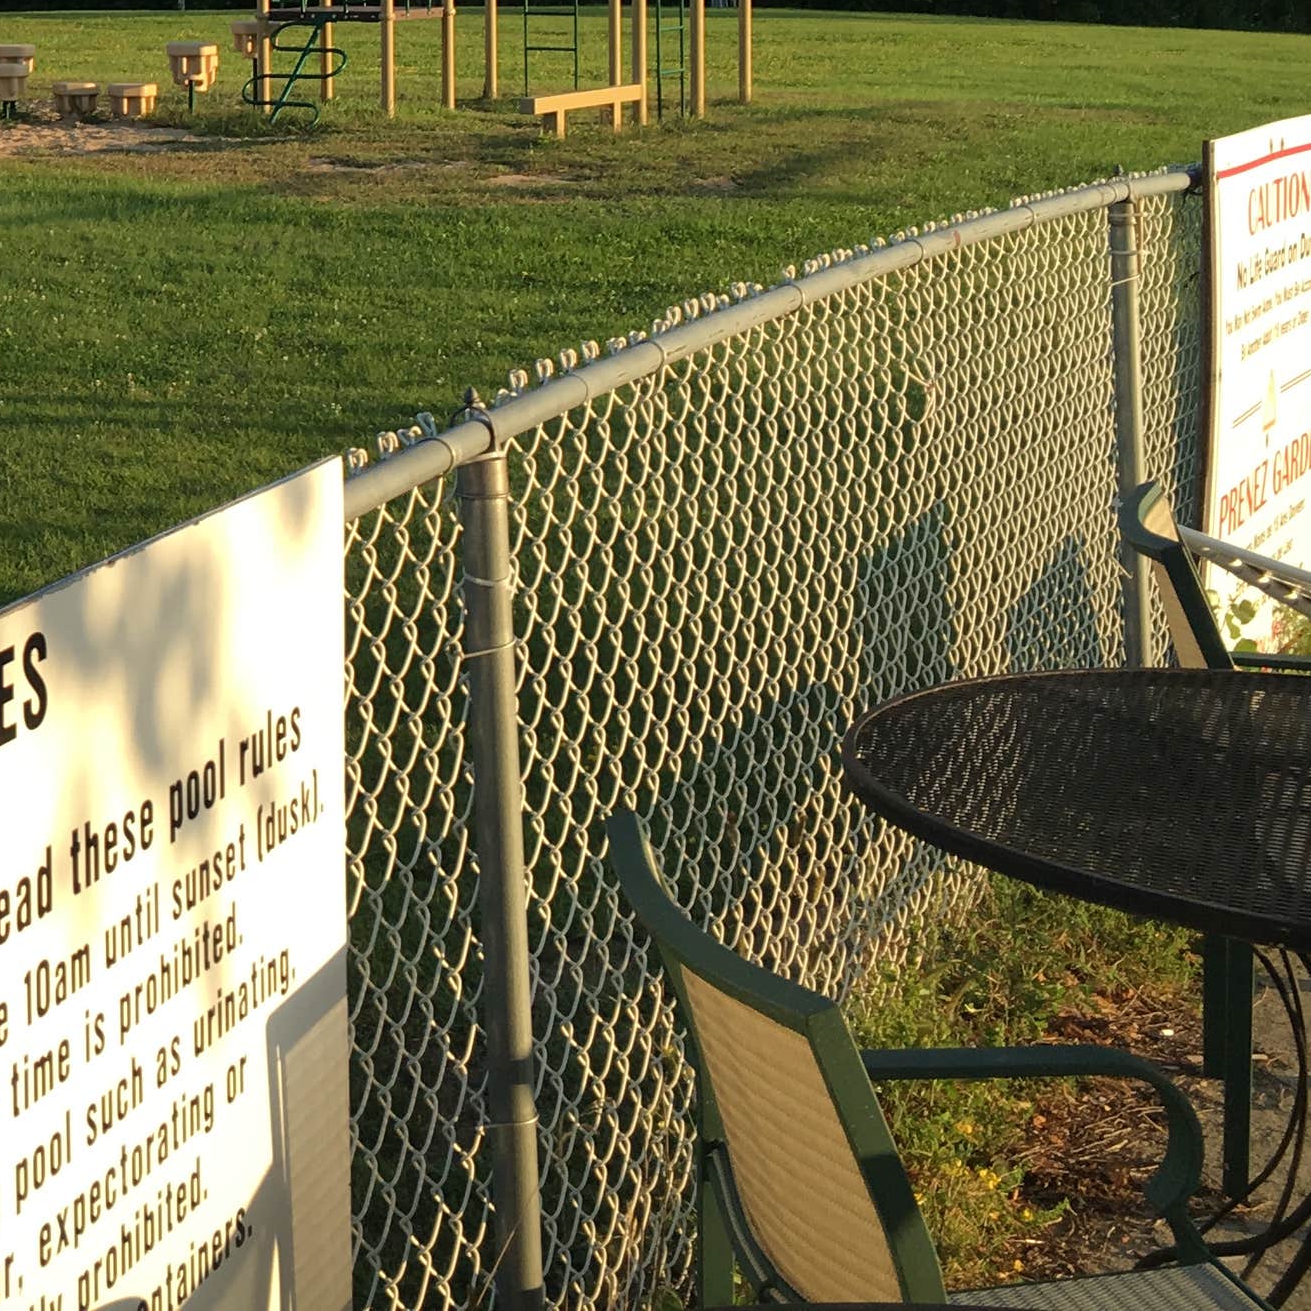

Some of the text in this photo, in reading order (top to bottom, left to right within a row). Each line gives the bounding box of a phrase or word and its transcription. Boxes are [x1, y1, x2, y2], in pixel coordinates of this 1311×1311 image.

[1237, 262, 1247, 289] No
[1250, 253, 1262, 285] Life
[1265, 241, 1285, 276] Guard
[1289, 243, 1298, 264] on
[1248, 171, 1311, 236] CAUTION
[1218, 458, 1268, 540] PRENEZ
[70, 799, 154, 896] these
[169, 737, 226, 844] pool
[239, 705, 302, 787] rules
[23, 943, 90, 1026] 10am
[105, 882, 159, 969] until
[172, 823, 246, 921] sunset
[256, 768, 324, 863] (dusk).
[10, 1039, 70, 1118] time
[85, 1008, 105, 1063] is
[120, 900, 243, 1046] prohibited.
[15, 1109, 71, 1215] pool
[86, 1056, 143, 1146] such
[156, 1036, 181, 1088] as
[193, 947, 296, 1057] urinating,
[39, 1082, 215, 1267] expectorating
[226, 1054, 247, 1104] or
[77, 1154, 208, 1311] prohibited.
